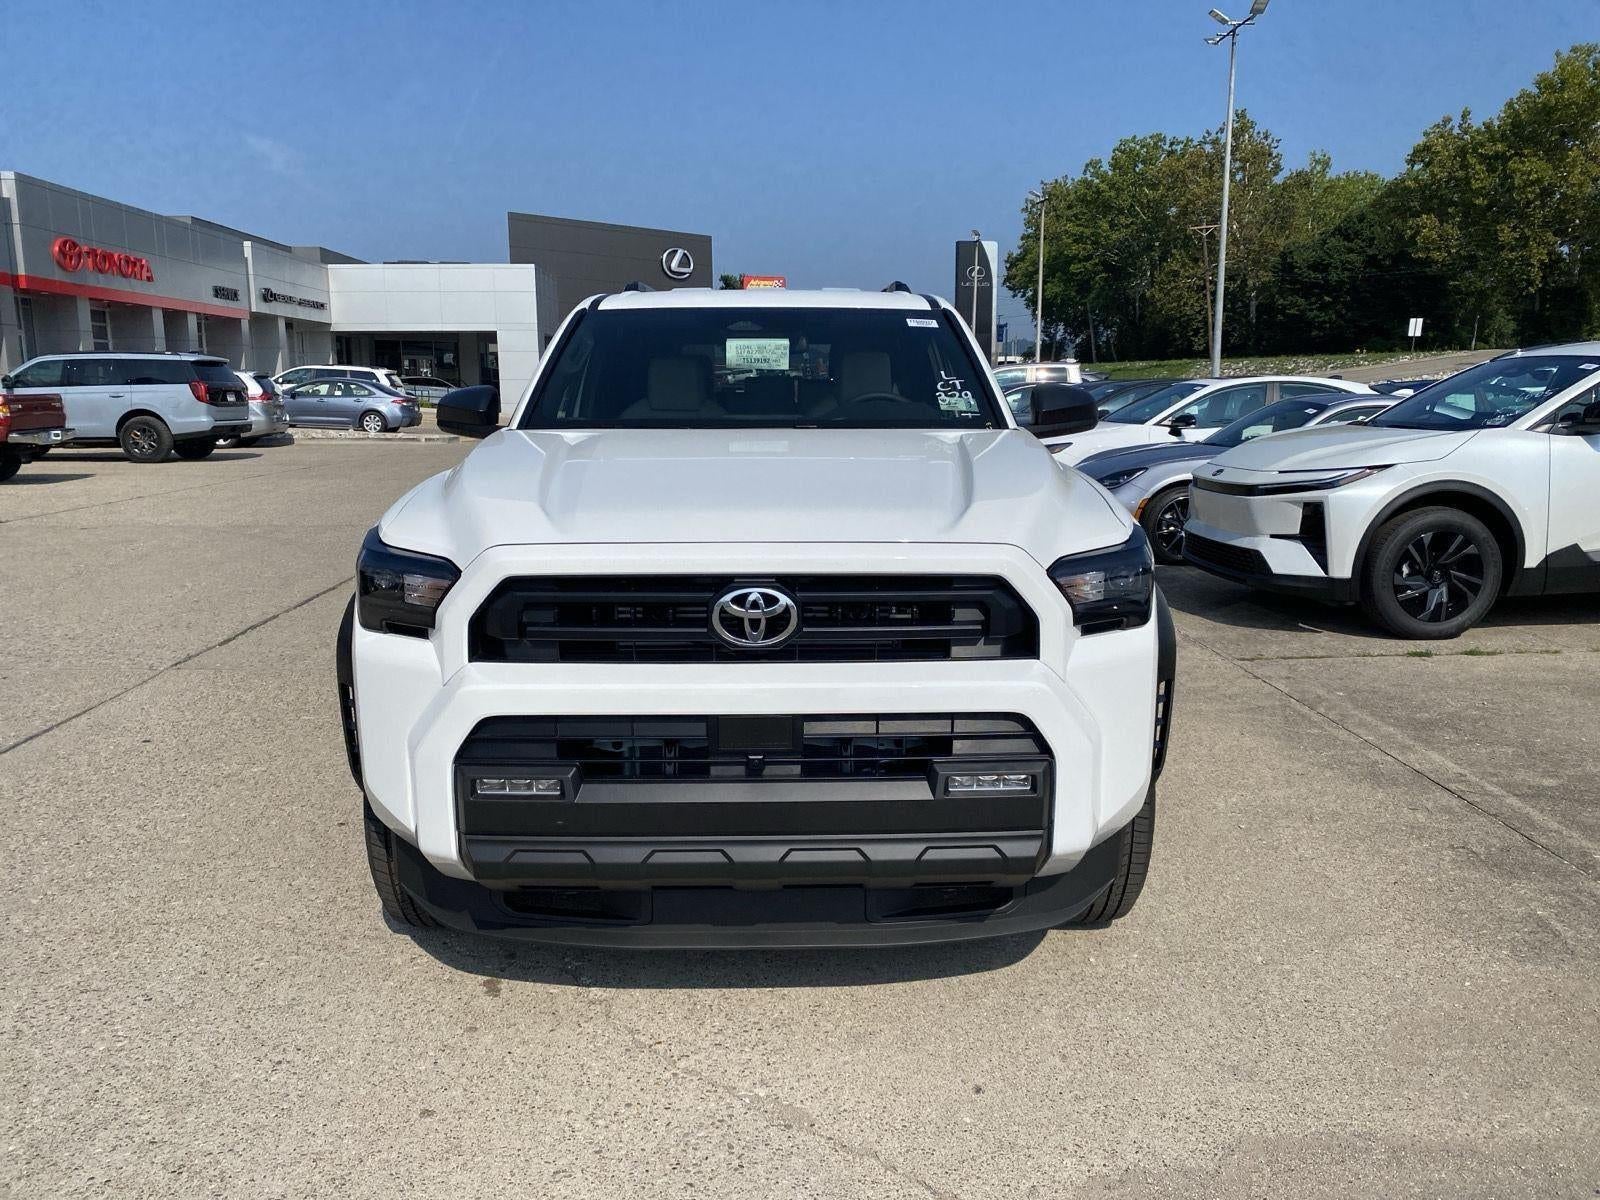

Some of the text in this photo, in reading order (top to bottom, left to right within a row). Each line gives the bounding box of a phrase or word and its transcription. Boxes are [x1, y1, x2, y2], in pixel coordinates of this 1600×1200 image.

[83, 245, 154, 282] TOYOTA
[299, 297, 328, 311] SERVICE
[936, 379, 965, 391] CT
